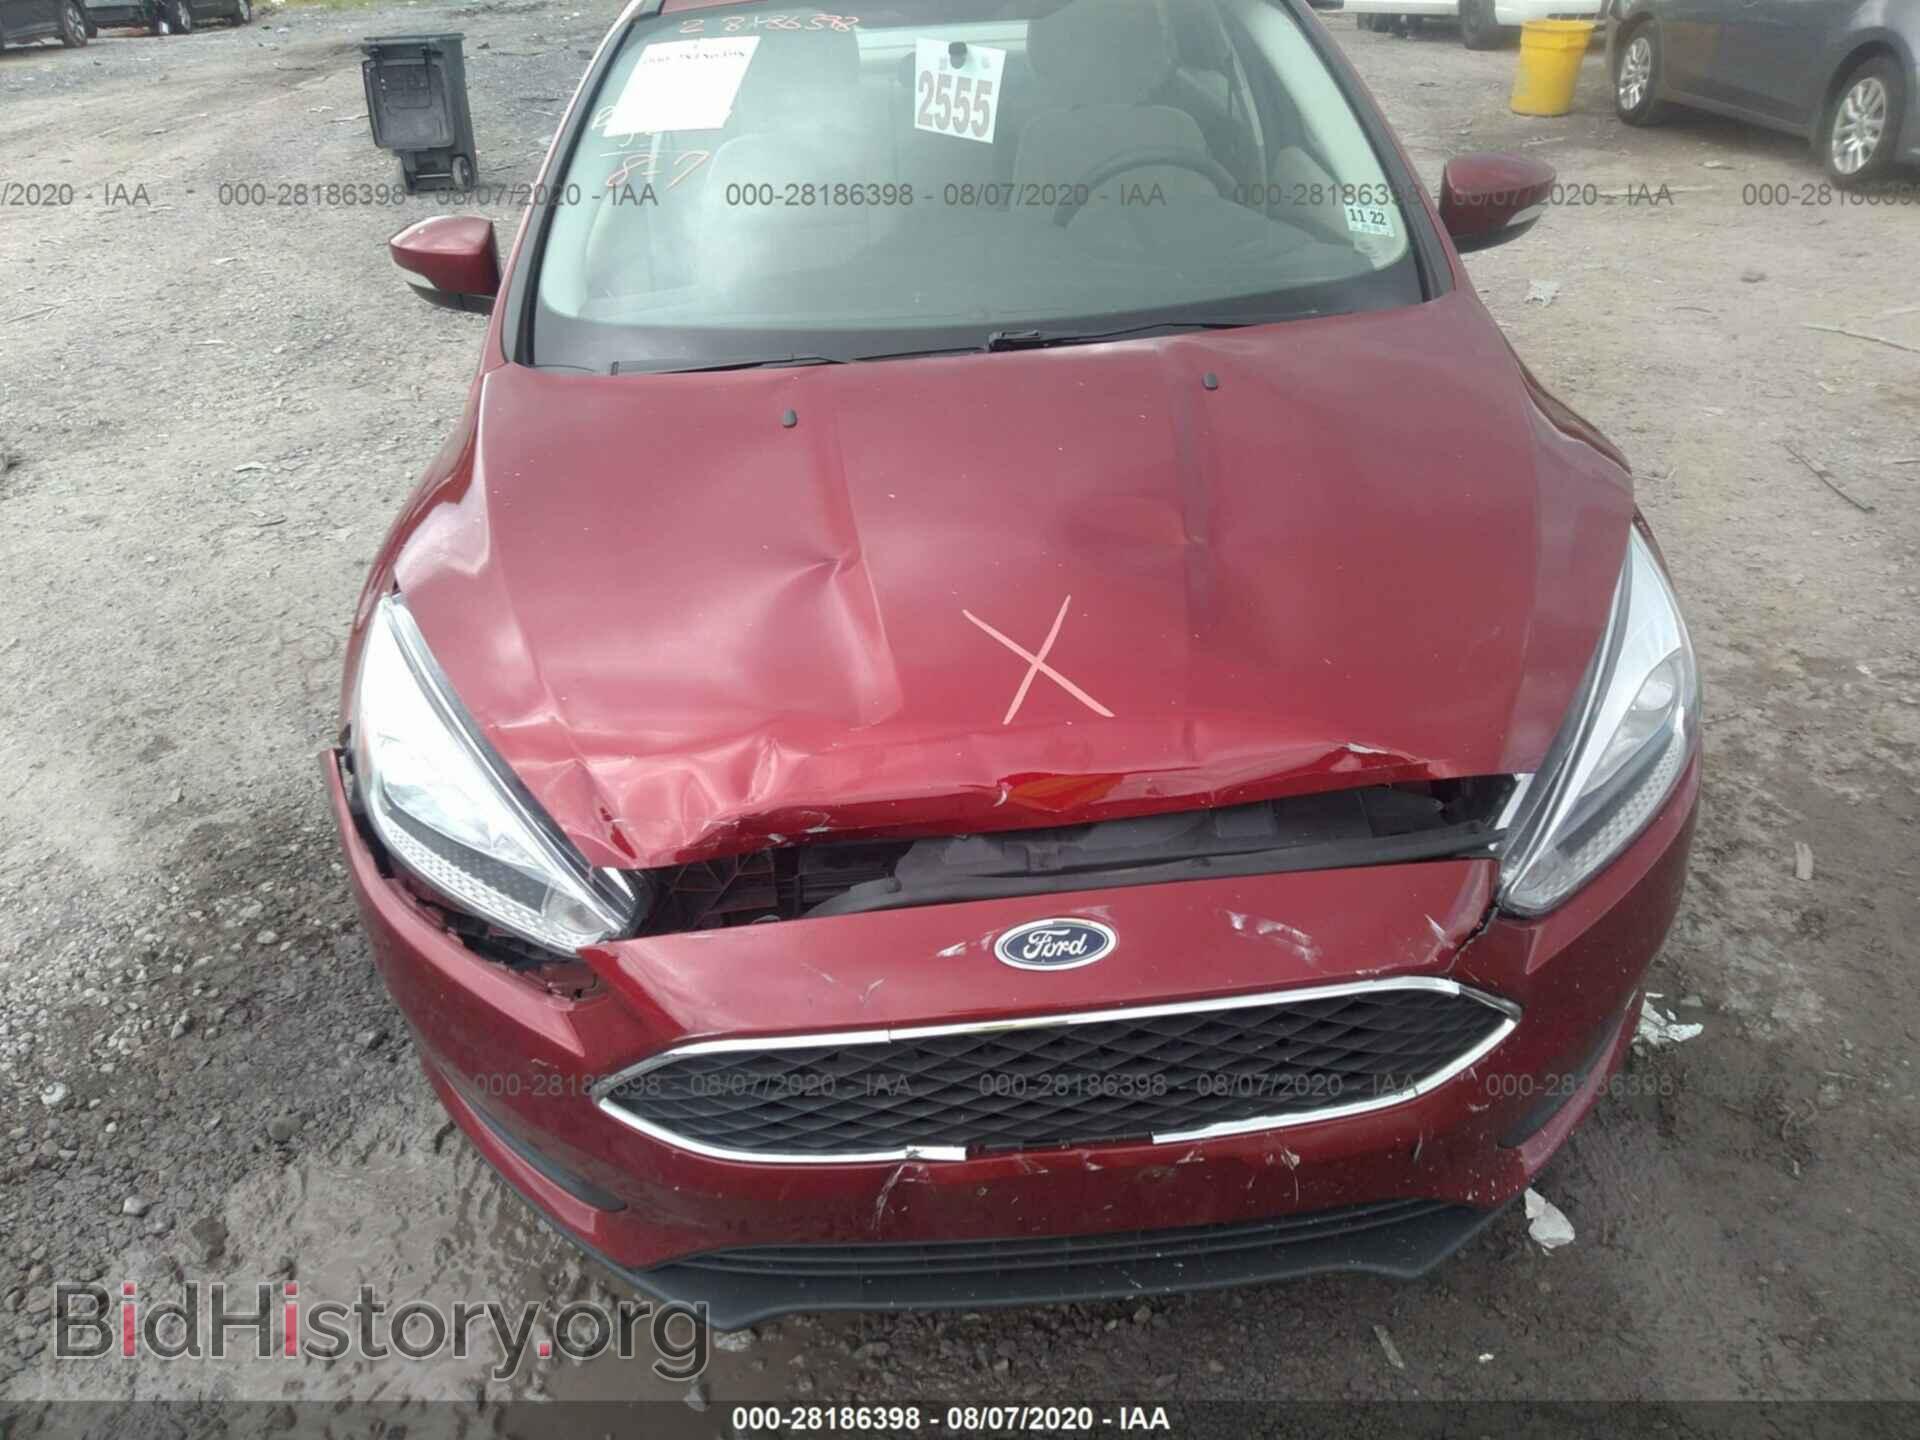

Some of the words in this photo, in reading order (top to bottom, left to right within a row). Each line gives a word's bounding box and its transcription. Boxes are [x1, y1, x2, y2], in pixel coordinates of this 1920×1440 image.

[918, 70, 993, 138] 2555
[1349, 208, 1367, 223] 11
[1370, 210, 1387, 226] 22
[1023, 928, 1088, 960] Ford
